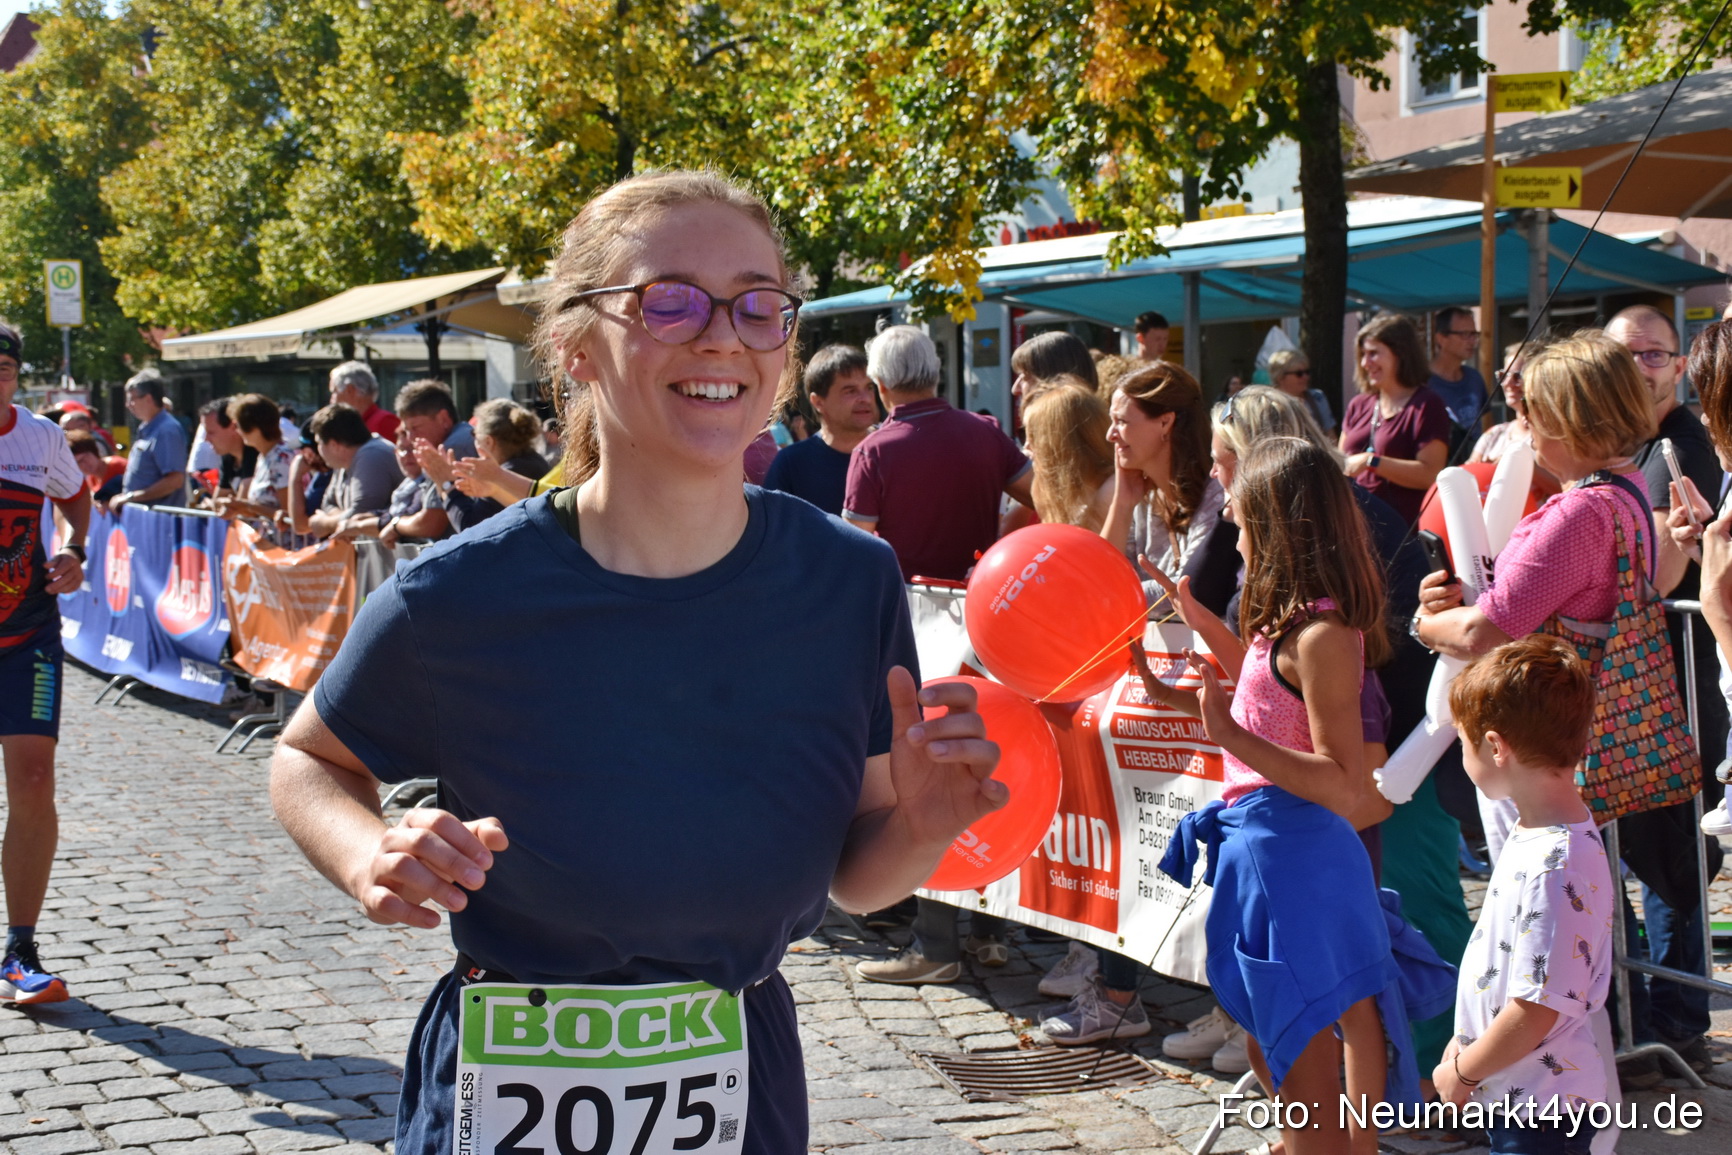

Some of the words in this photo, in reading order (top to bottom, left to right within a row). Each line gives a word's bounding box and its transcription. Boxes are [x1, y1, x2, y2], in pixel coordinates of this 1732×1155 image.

[31, 662, 55, 721] PUMA
[1117, 718, 1211, 741] RUNDSCHLING
[1123, 750, 1205, 775] HEBEBÄNDER
[1134, 787, 1166, 807] Braun
[1168, 792, 1195, 812] GmbH
[1139, 807, 1153, 825] Am
[1139, 829, 1171, 850] D-9231
[951, 843, 985, 869] nergie
[1139, 859, 1154, 878] Tel.
[1049, 869, 1078, 891] Sicher
[1081, 876, 1094, 893] ist
[1095, 882, 1121, 901] sicher
[1138, 880, 1153, 899] Fax
[489, 994, 717, 1052] BOCK
[726, 1075, 737, 1089] D
[494, 1072, 718, 1155] 2075
